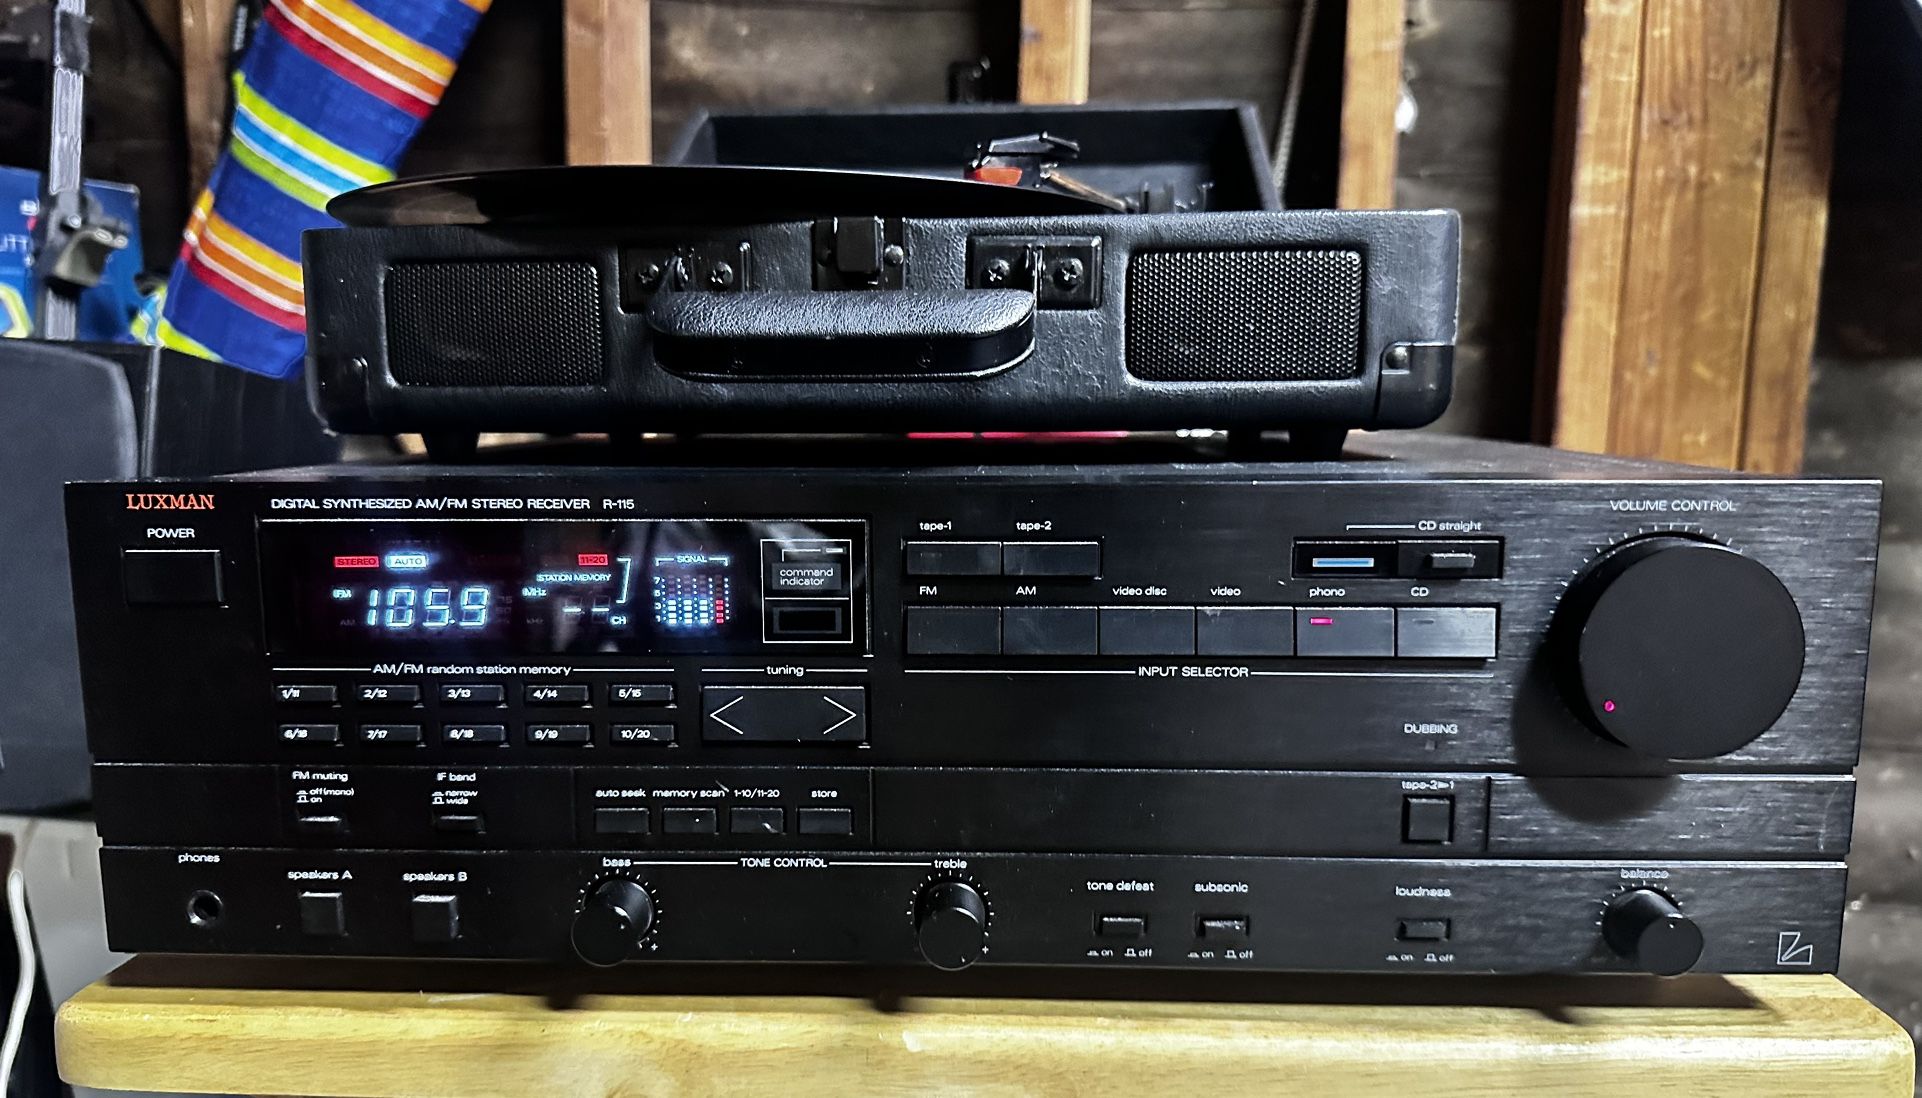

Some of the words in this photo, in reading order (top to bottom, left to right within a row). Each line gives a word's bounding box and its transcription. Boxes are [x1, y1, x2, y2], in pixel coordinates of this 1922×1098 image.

[126, 493, 215, 510] LUXMAN
[271, 498, 320, 510] DIGITAL
[323, 498, 412, 510] SYNTHESIZED
[415, 497, 468, 510] AM/FM
[472, 498, 524, 510] STEREO
[527, 499, 590, 510] RECEIVER
[603, 499, 635, 510] R-115
[1610, 500, 1667, 511] VOLUME
[1671, 500, 1737, 511] CONTROL
[919, 521, 952, 531] tape-1
[1016, 521, 1052, 531] tape-2
[1418, 520, 1437, 531] CD
[1439, 520, 1482, 533] straight
[147, 528, 195, 538] POWER
[336, 557, 377, 566] STEREO
[394, 557, 424, 566] AUTO
[580, 555, 606, 565] 11-20
[677, 555, 708, 563] SIGNAL
[537, 573, 572, 582] STATION
[574, 573, 611, 582] MEMORY
[779, 568, 833, 577] command
[779, 577, 825, 587] indicator
[919, 586, 938, 595] FM
[1016, 586, 1037, 595] AM
[1112, 586, 1143, 596] video
[1145, 586, 1168, 596] disc
[1210, 586, 1242, 596] video
[1309, 586, 1346, 598] phono
[1410, 587, 1430, 597] CD
[366, 587, 490, 627] 105.9
[611, 616, 627, 625] CH
[373, 663, 425, 675] AM/FM
[427, 664, 474, 674] random
[476, 664, 517, 674] station
[519, 666, 572, 677] memory
[766, 664, 804, 677] tuning
[1138, 666, 1178, 677] INPUT
[1181, 667, 1249, 678] SELECTOR
[363, 688, 388, 699] 2/12
[447, 688, 472, 699] 3/13
[533, 688, 558, 699] 4/14
[367, 728, 388, 739] 7/17
[1404, 723, 1459, 734] DUBBING
[534, 729, 559, 740] 9/19
[620, 728, 651, 740] 10/20
[292, 771, 310, 780] FM
[312, 771, 349, 782] muting
[449, 772, 477, 782] band
[596, 789, 619, 798] auto
[652, 789, 698, 799] memory
[700, 789, 726, 798] scan
[733, 788, 780, 799] 1-10/11-20
[811, 789, 838, 798] store
[310, 796, 323, 804] on
[446, 796, 469, 805] wide
[178, 852, 220, 863] phones
[602, 856, 632, 867] bass
[740, 858, 771, 868] TONE
[773, 858, 828, 868] CONTROL
[934, 857, 968, 869] treble
[287, 870, 339, 880] speakers
[342, 870, 353, 879] A
[402, 871, 455, 882] speakers
[458, 872, 468, 882] B
[1620, 868, 1669, 879] balance
[1086, 880, 1114, 891] tone
[1116, 880, 1155, 891] defeat
[1194, 881, 1249, 892] subsonic
[1395, 886, 1451, 897] loudness
[1101, 949, 1114, 957] on
[1139, 948, 1153, 957] off
[1201, 950, 1214, 959] on
[1239, 949, 1254, 959] off
[1401, 953, 1414, 962] on
